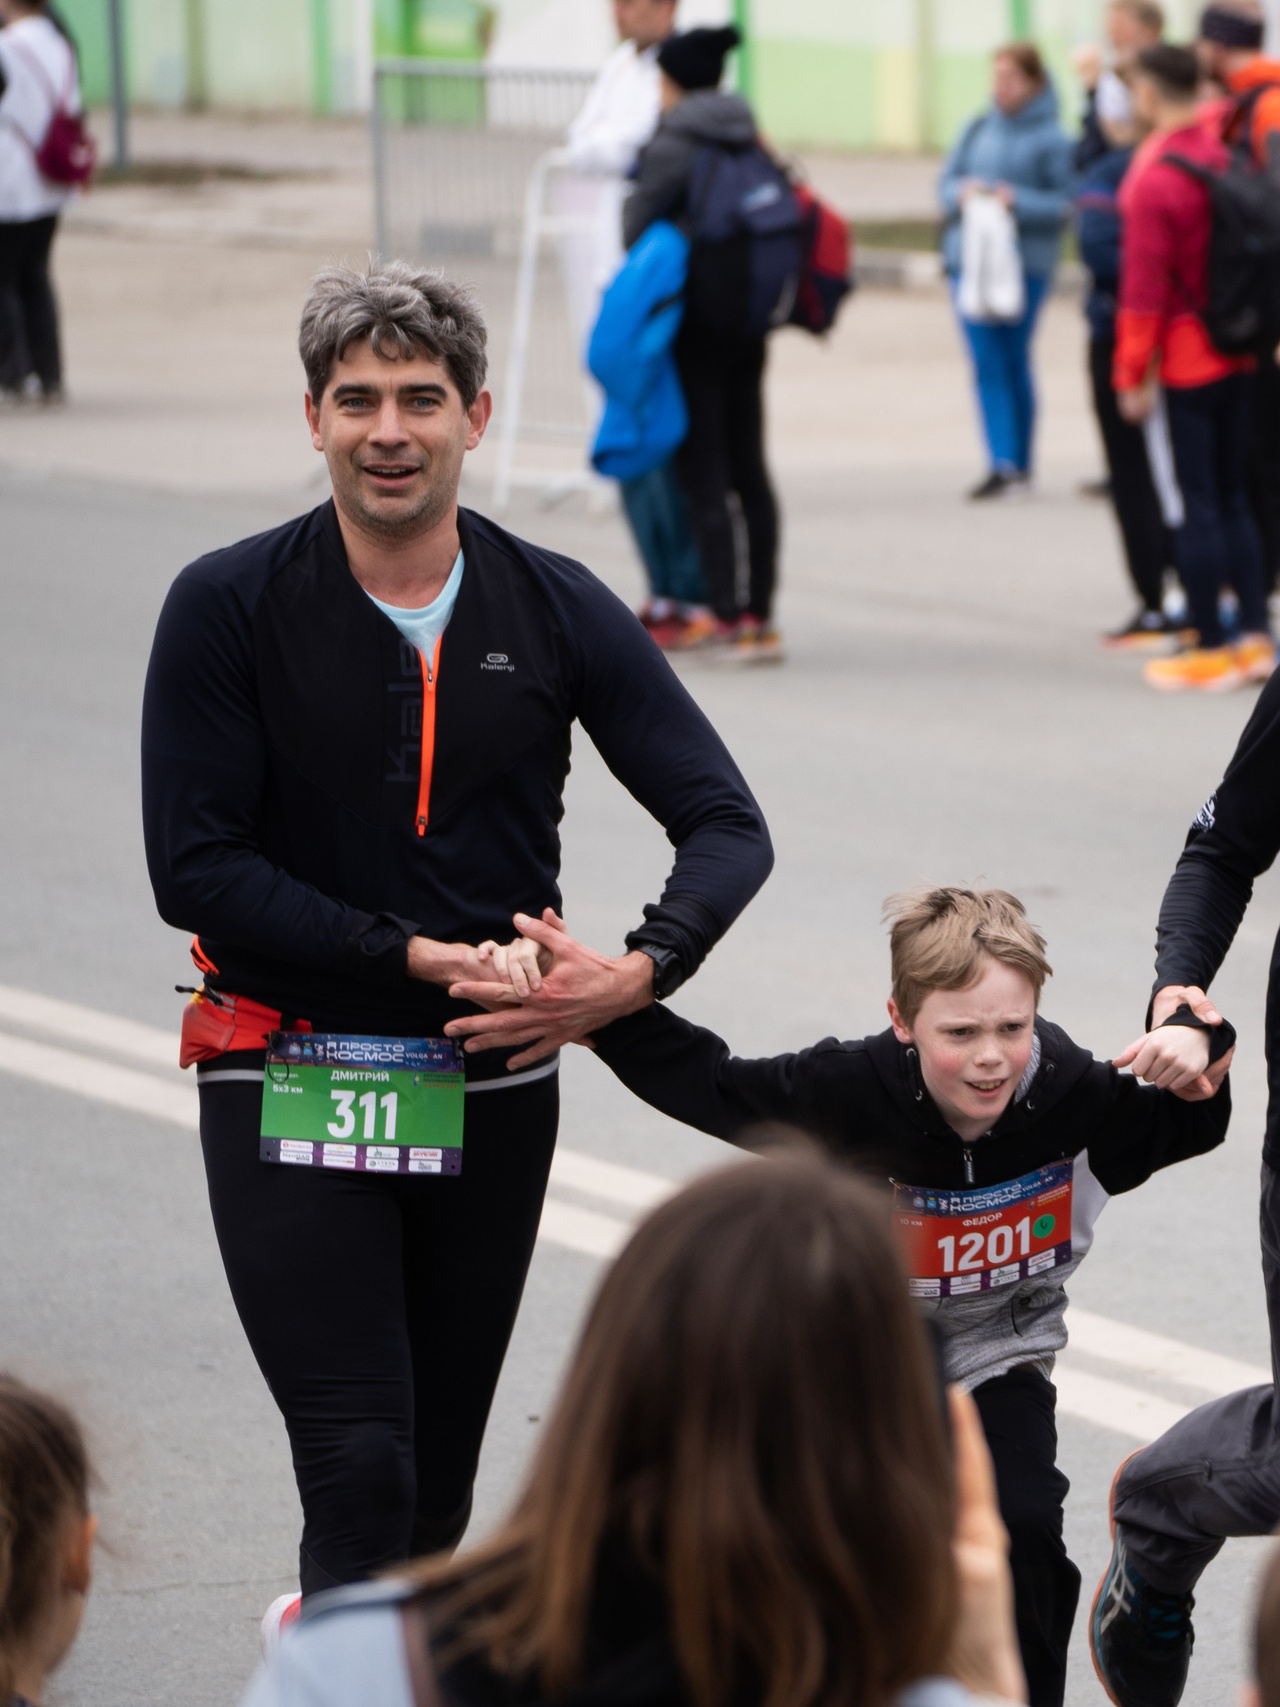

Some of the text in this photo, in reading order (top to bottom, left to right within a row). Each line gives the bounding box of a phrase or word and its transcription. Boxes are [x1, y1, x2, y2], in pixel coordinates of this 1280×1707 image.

[480, 661, 515, 673] Kalenji
[339, 1042, 405, 1053] ПРОСТО
[326, 1050, 405, 1063] КОСМОС
[330, 1070, 390, 1082] ДМИТРИЙ
[291, 1086, 303, 1094] км
[326, 1089, 398, 1141] 311
[962, 1183, 1022, 1203] ПРОСТО
[950, 1190, 1022, 1213] КОСМОС
[963, 1212, 1003, 1227] ФЕДОР
[937, 1216, 1031, 1273] 1201
